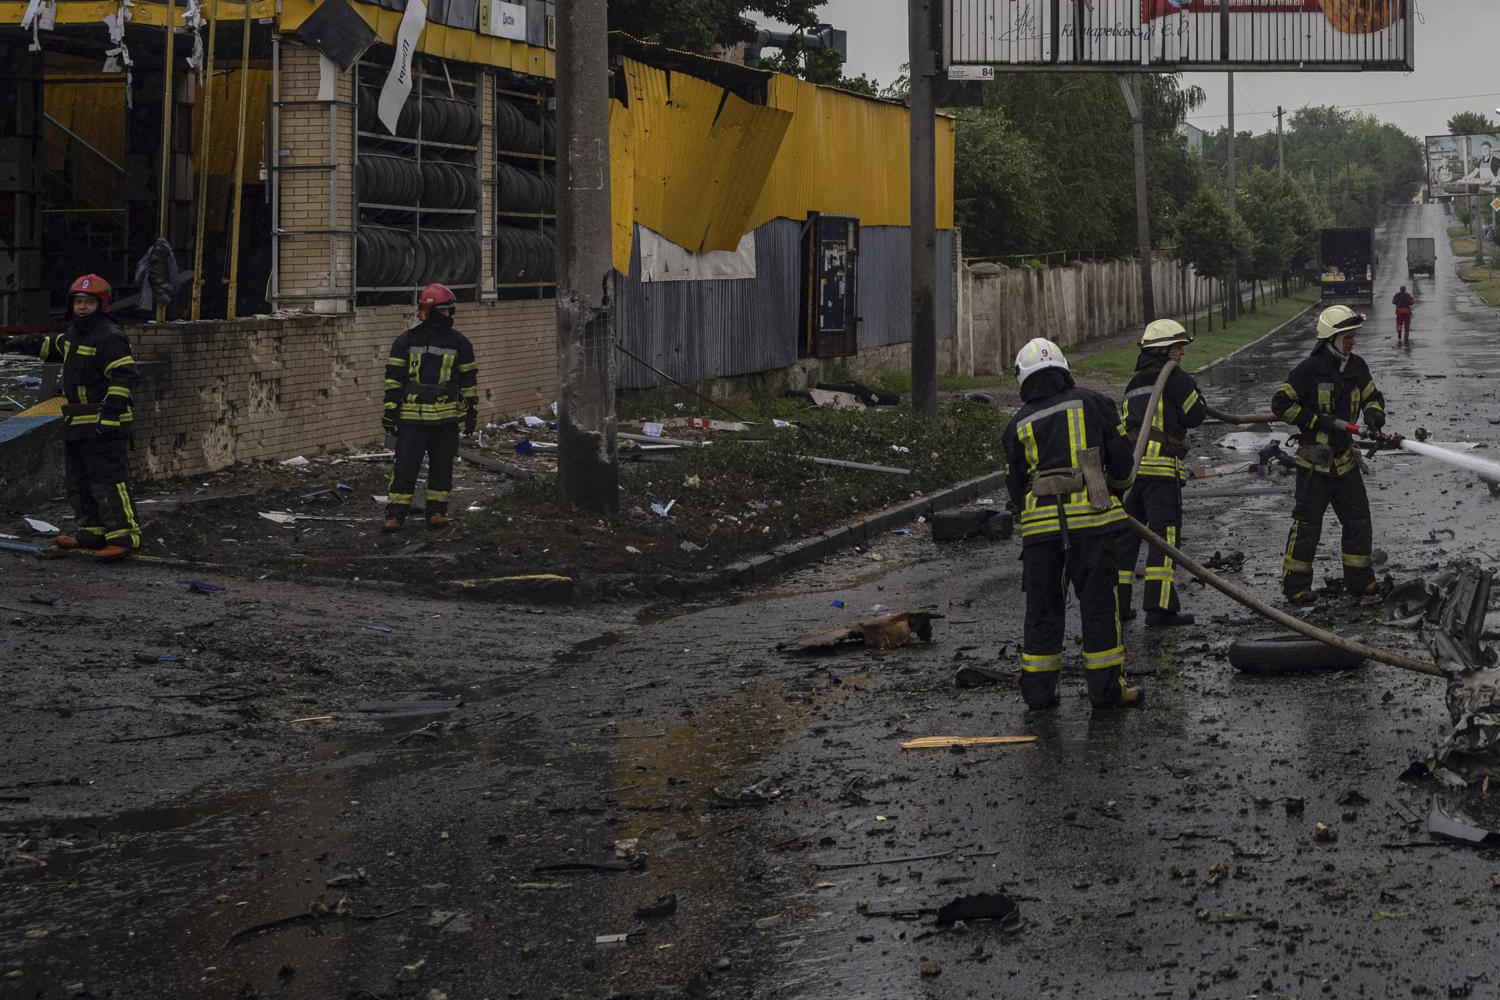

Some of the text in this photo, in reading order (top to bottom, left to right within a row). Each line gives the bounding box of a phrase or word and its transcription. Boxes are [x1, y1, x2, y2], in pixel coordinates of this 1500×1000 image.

[982, 67, 993, 76] 84
[82, 279, 90, 289] 9
[1041, 349, 1049, 358] 9
